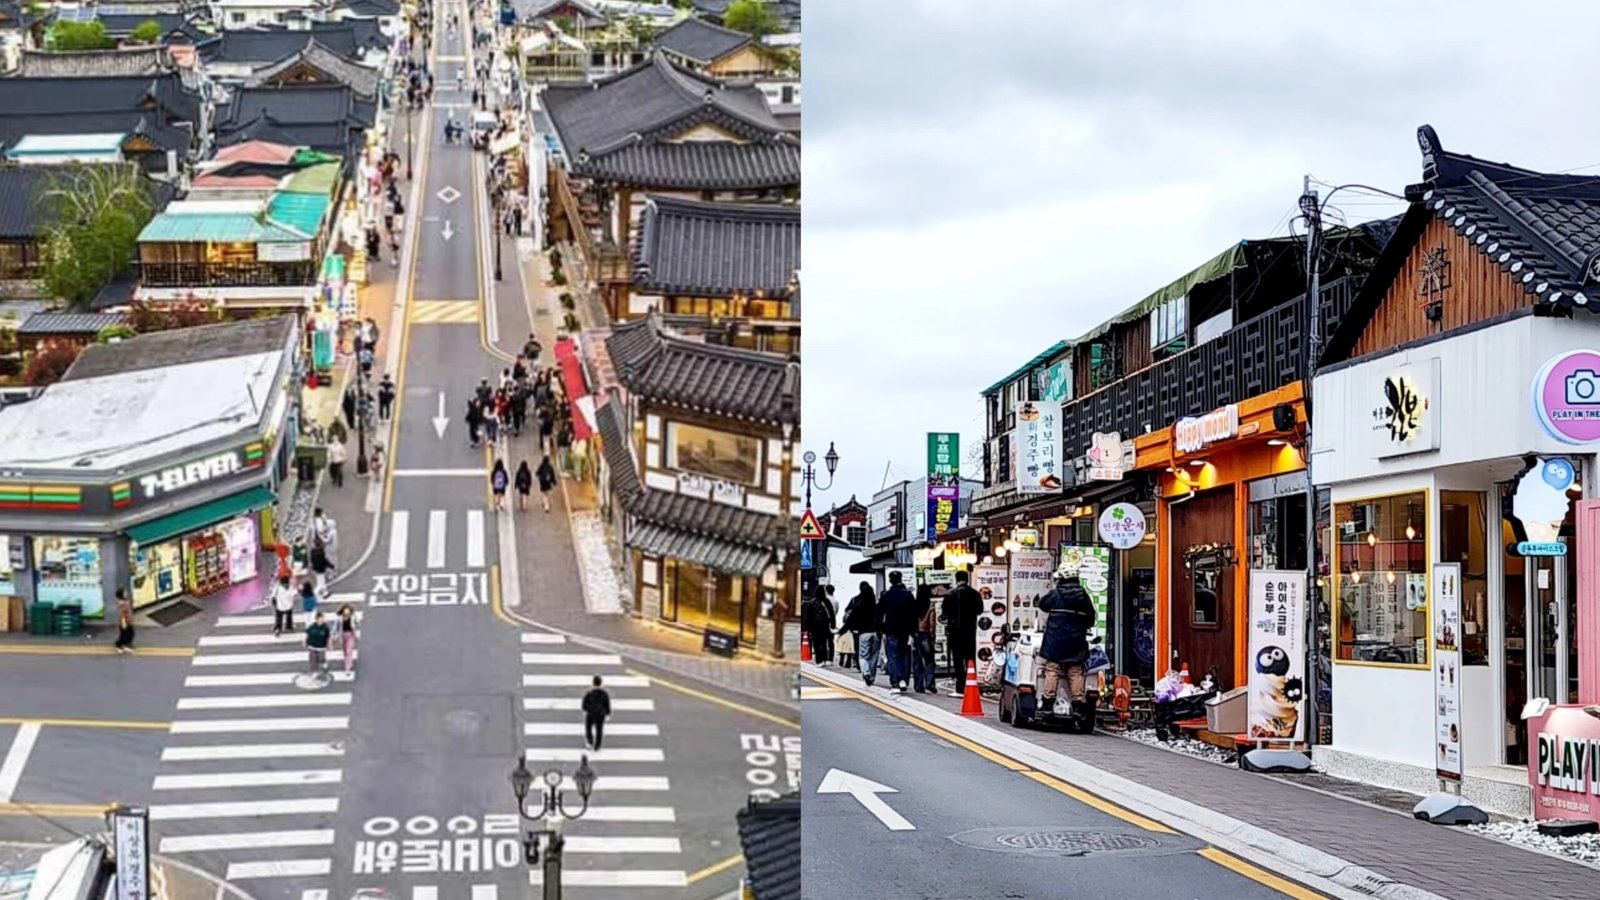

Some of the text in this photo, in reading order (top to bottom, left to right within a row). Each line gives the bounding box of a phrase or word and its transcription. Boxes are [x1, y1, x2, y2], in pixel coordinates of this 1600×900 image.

[1552, 410, 1600, 419] PLAY IN THE
[1041, 414, 1056, 474] 찰보리빵
[368, 572, 488, 607] 진입금지
[1264, 581, 1275, 614] 순두부
[1277, 581, 1288, 636] 아이스크림
[1538, 732, 1588, 792] PLAY
